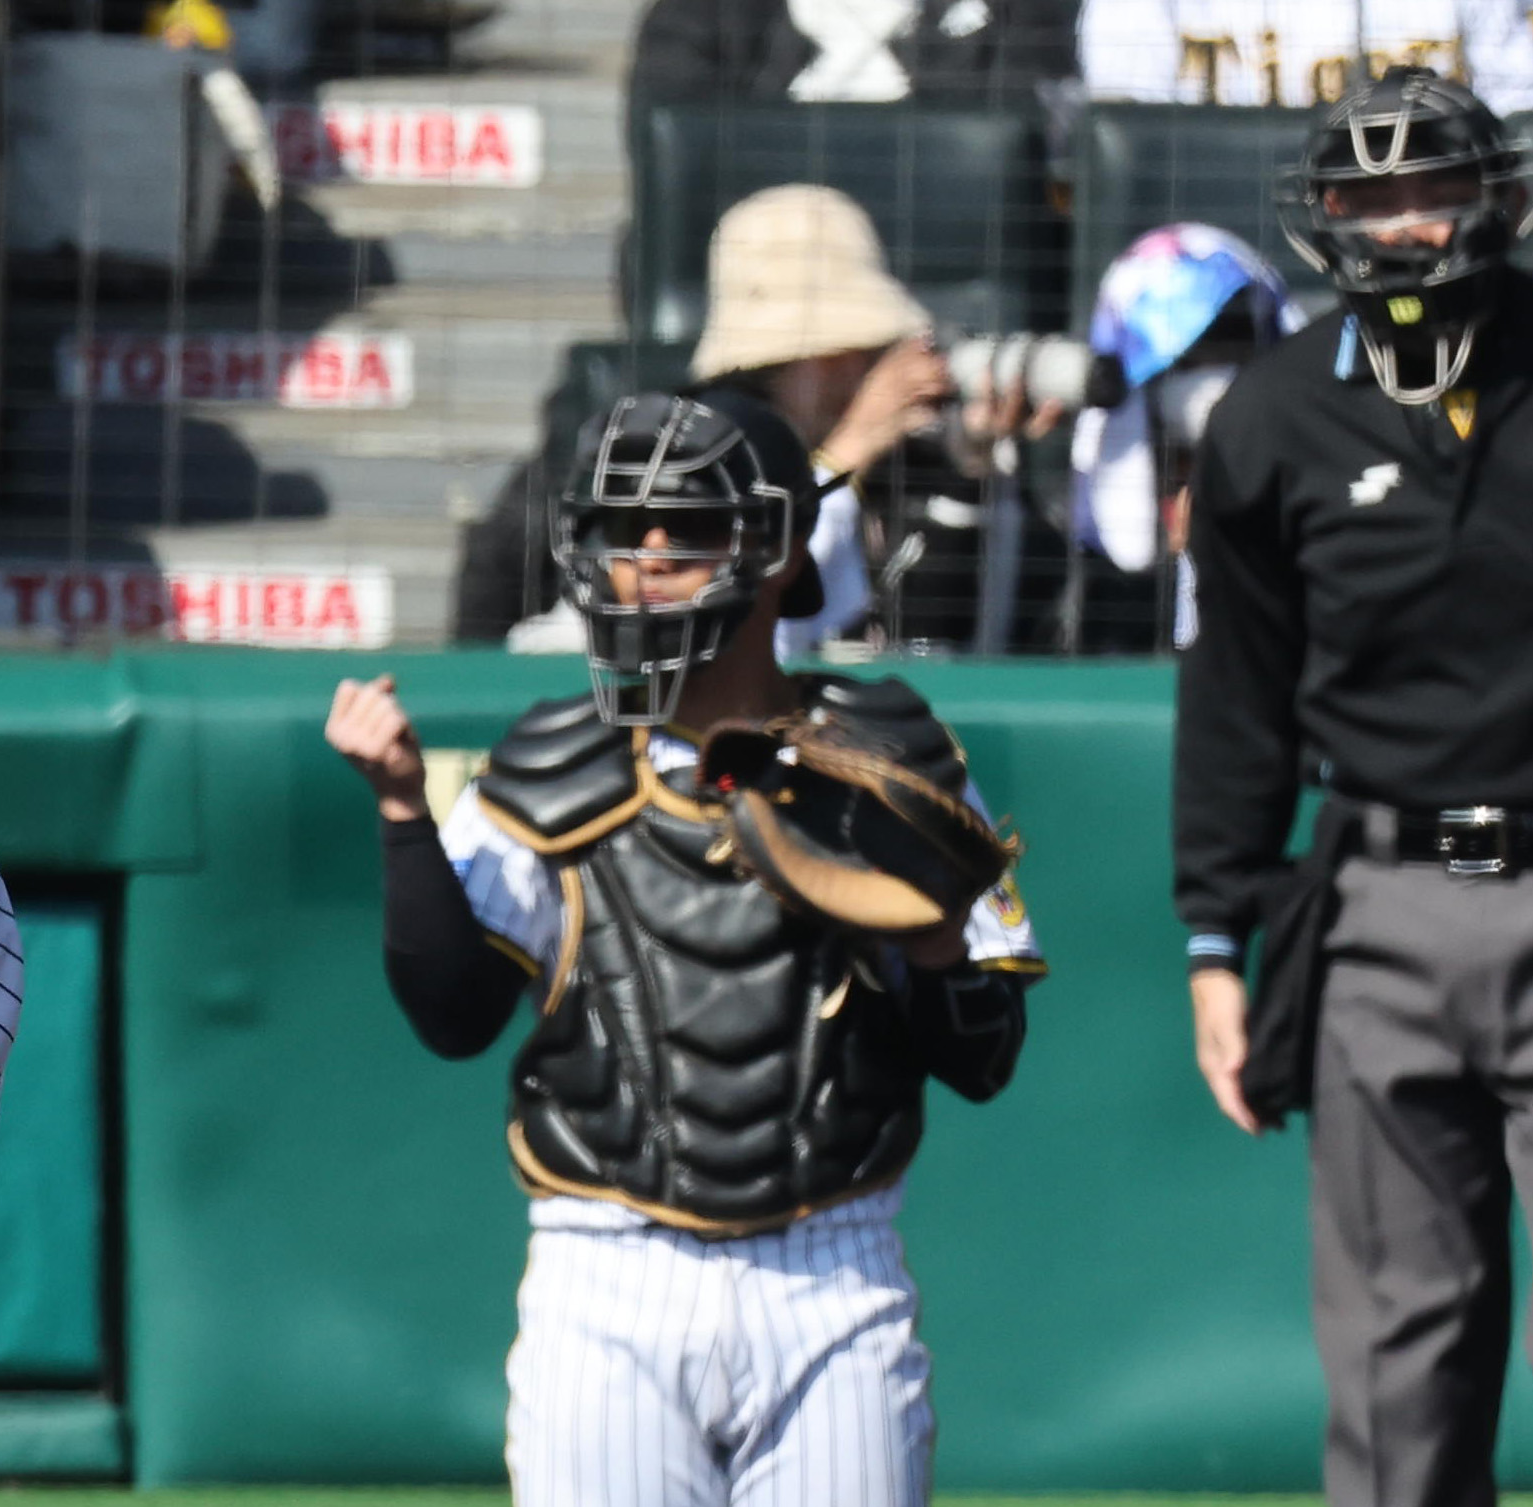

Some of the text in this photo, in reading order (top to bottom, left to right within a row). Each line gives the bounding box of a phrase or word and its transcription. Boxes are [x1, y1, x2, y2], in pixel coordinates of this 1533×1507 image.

[276, 111, 516, 178] SHIBA
[88, 336, 395, 398] TOSHIBA
[6, 569, 366, 636] TOSHIBA
